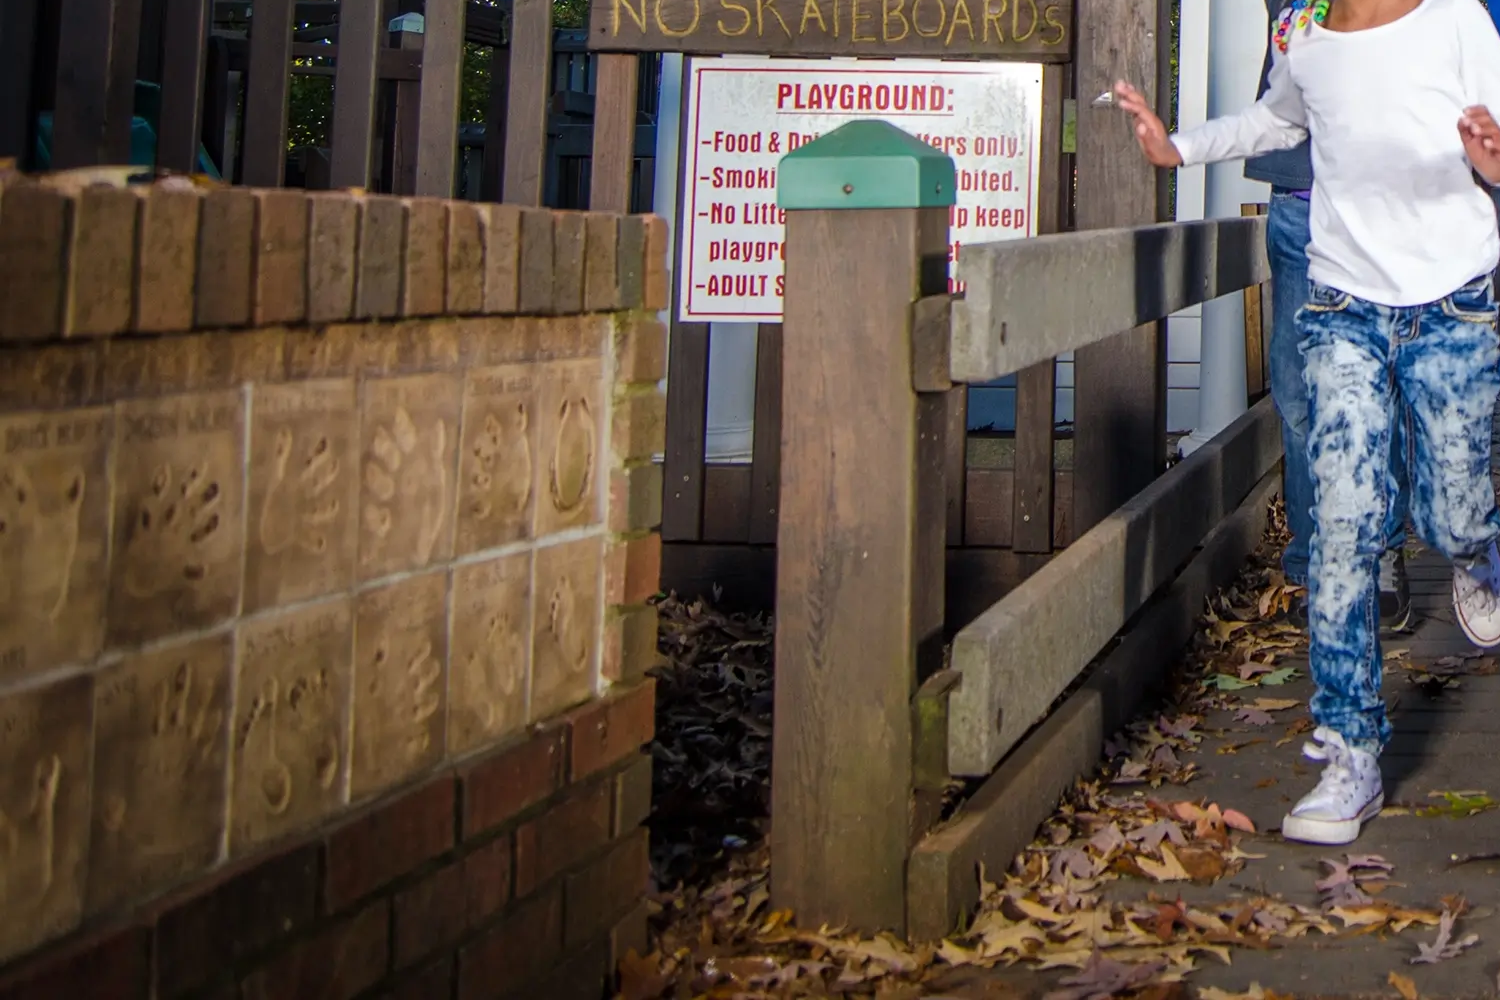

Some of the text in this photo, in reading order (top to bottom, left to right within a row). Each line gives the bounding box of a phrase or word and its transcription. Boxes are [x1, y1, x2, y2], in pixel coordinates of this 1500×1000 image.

[777, 83, 954, 112] PLAYGROUND:
[768, 131, 781, 153] &
[974, 134, 1024, 158] only.
[700, 167, 776, 189] -Smoki
[743, 203, 786, 225] Litte
[975, 205, 1025, 229] keep
